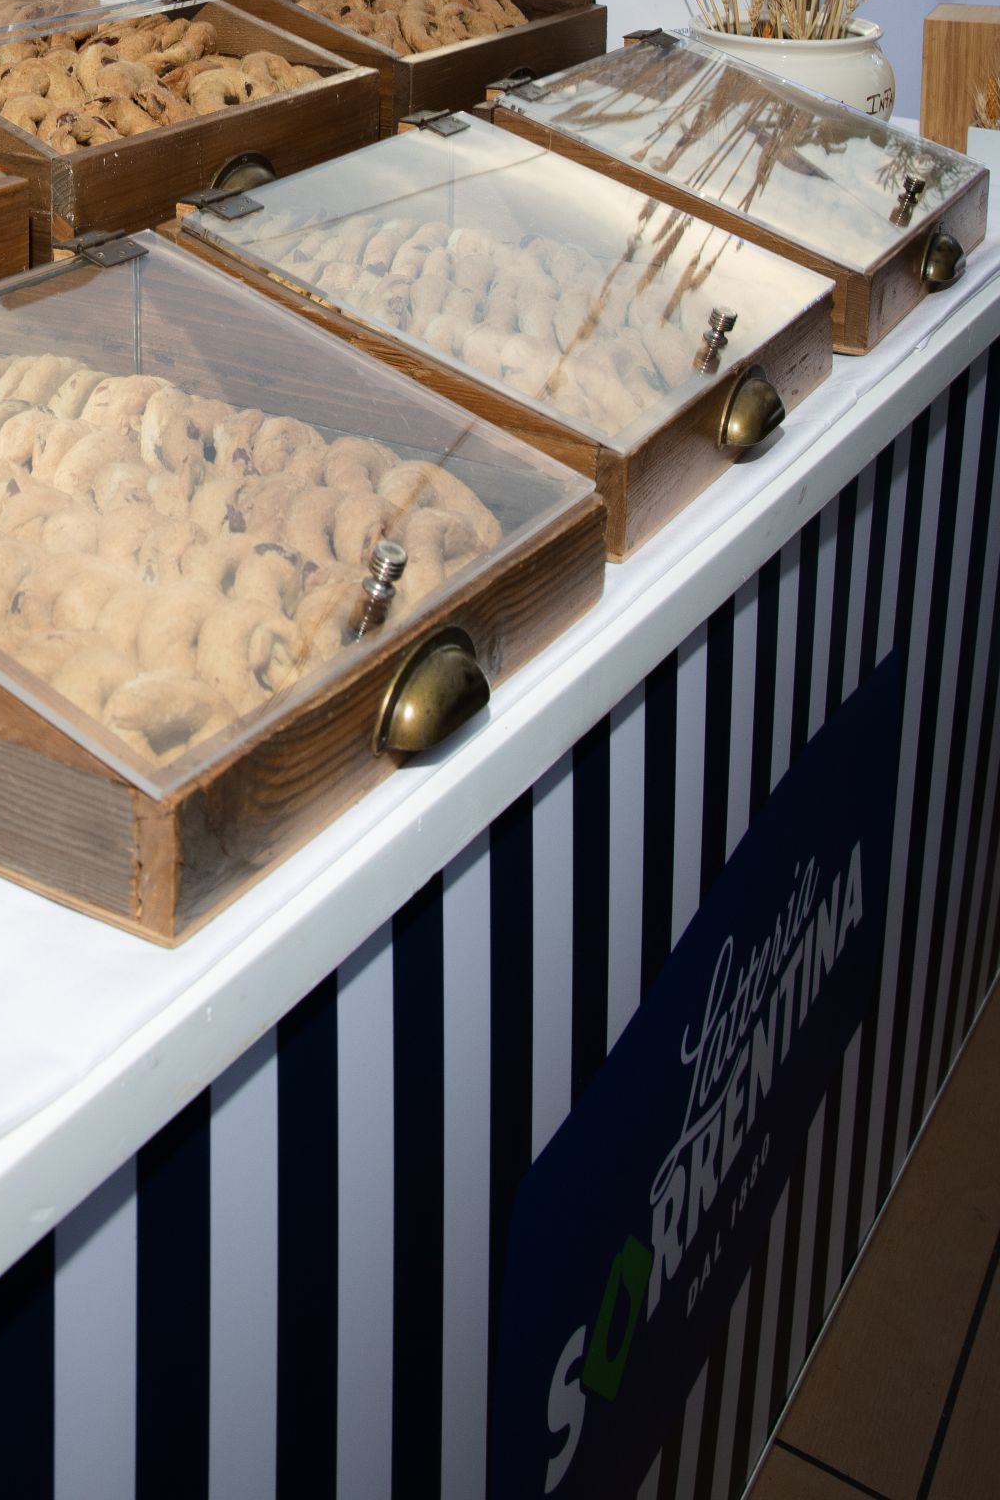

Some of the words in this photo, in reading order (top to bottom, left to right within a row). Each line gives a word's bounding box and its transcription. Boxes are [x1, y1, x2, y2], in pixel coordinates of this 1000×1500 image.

[543, 840, 864, 1495] SORRENTINA
[650, 855, 820, 1206] Latteria
[686, 1231, 723, 1319] DAL
[731, 1132, 772, 1230] 1880
